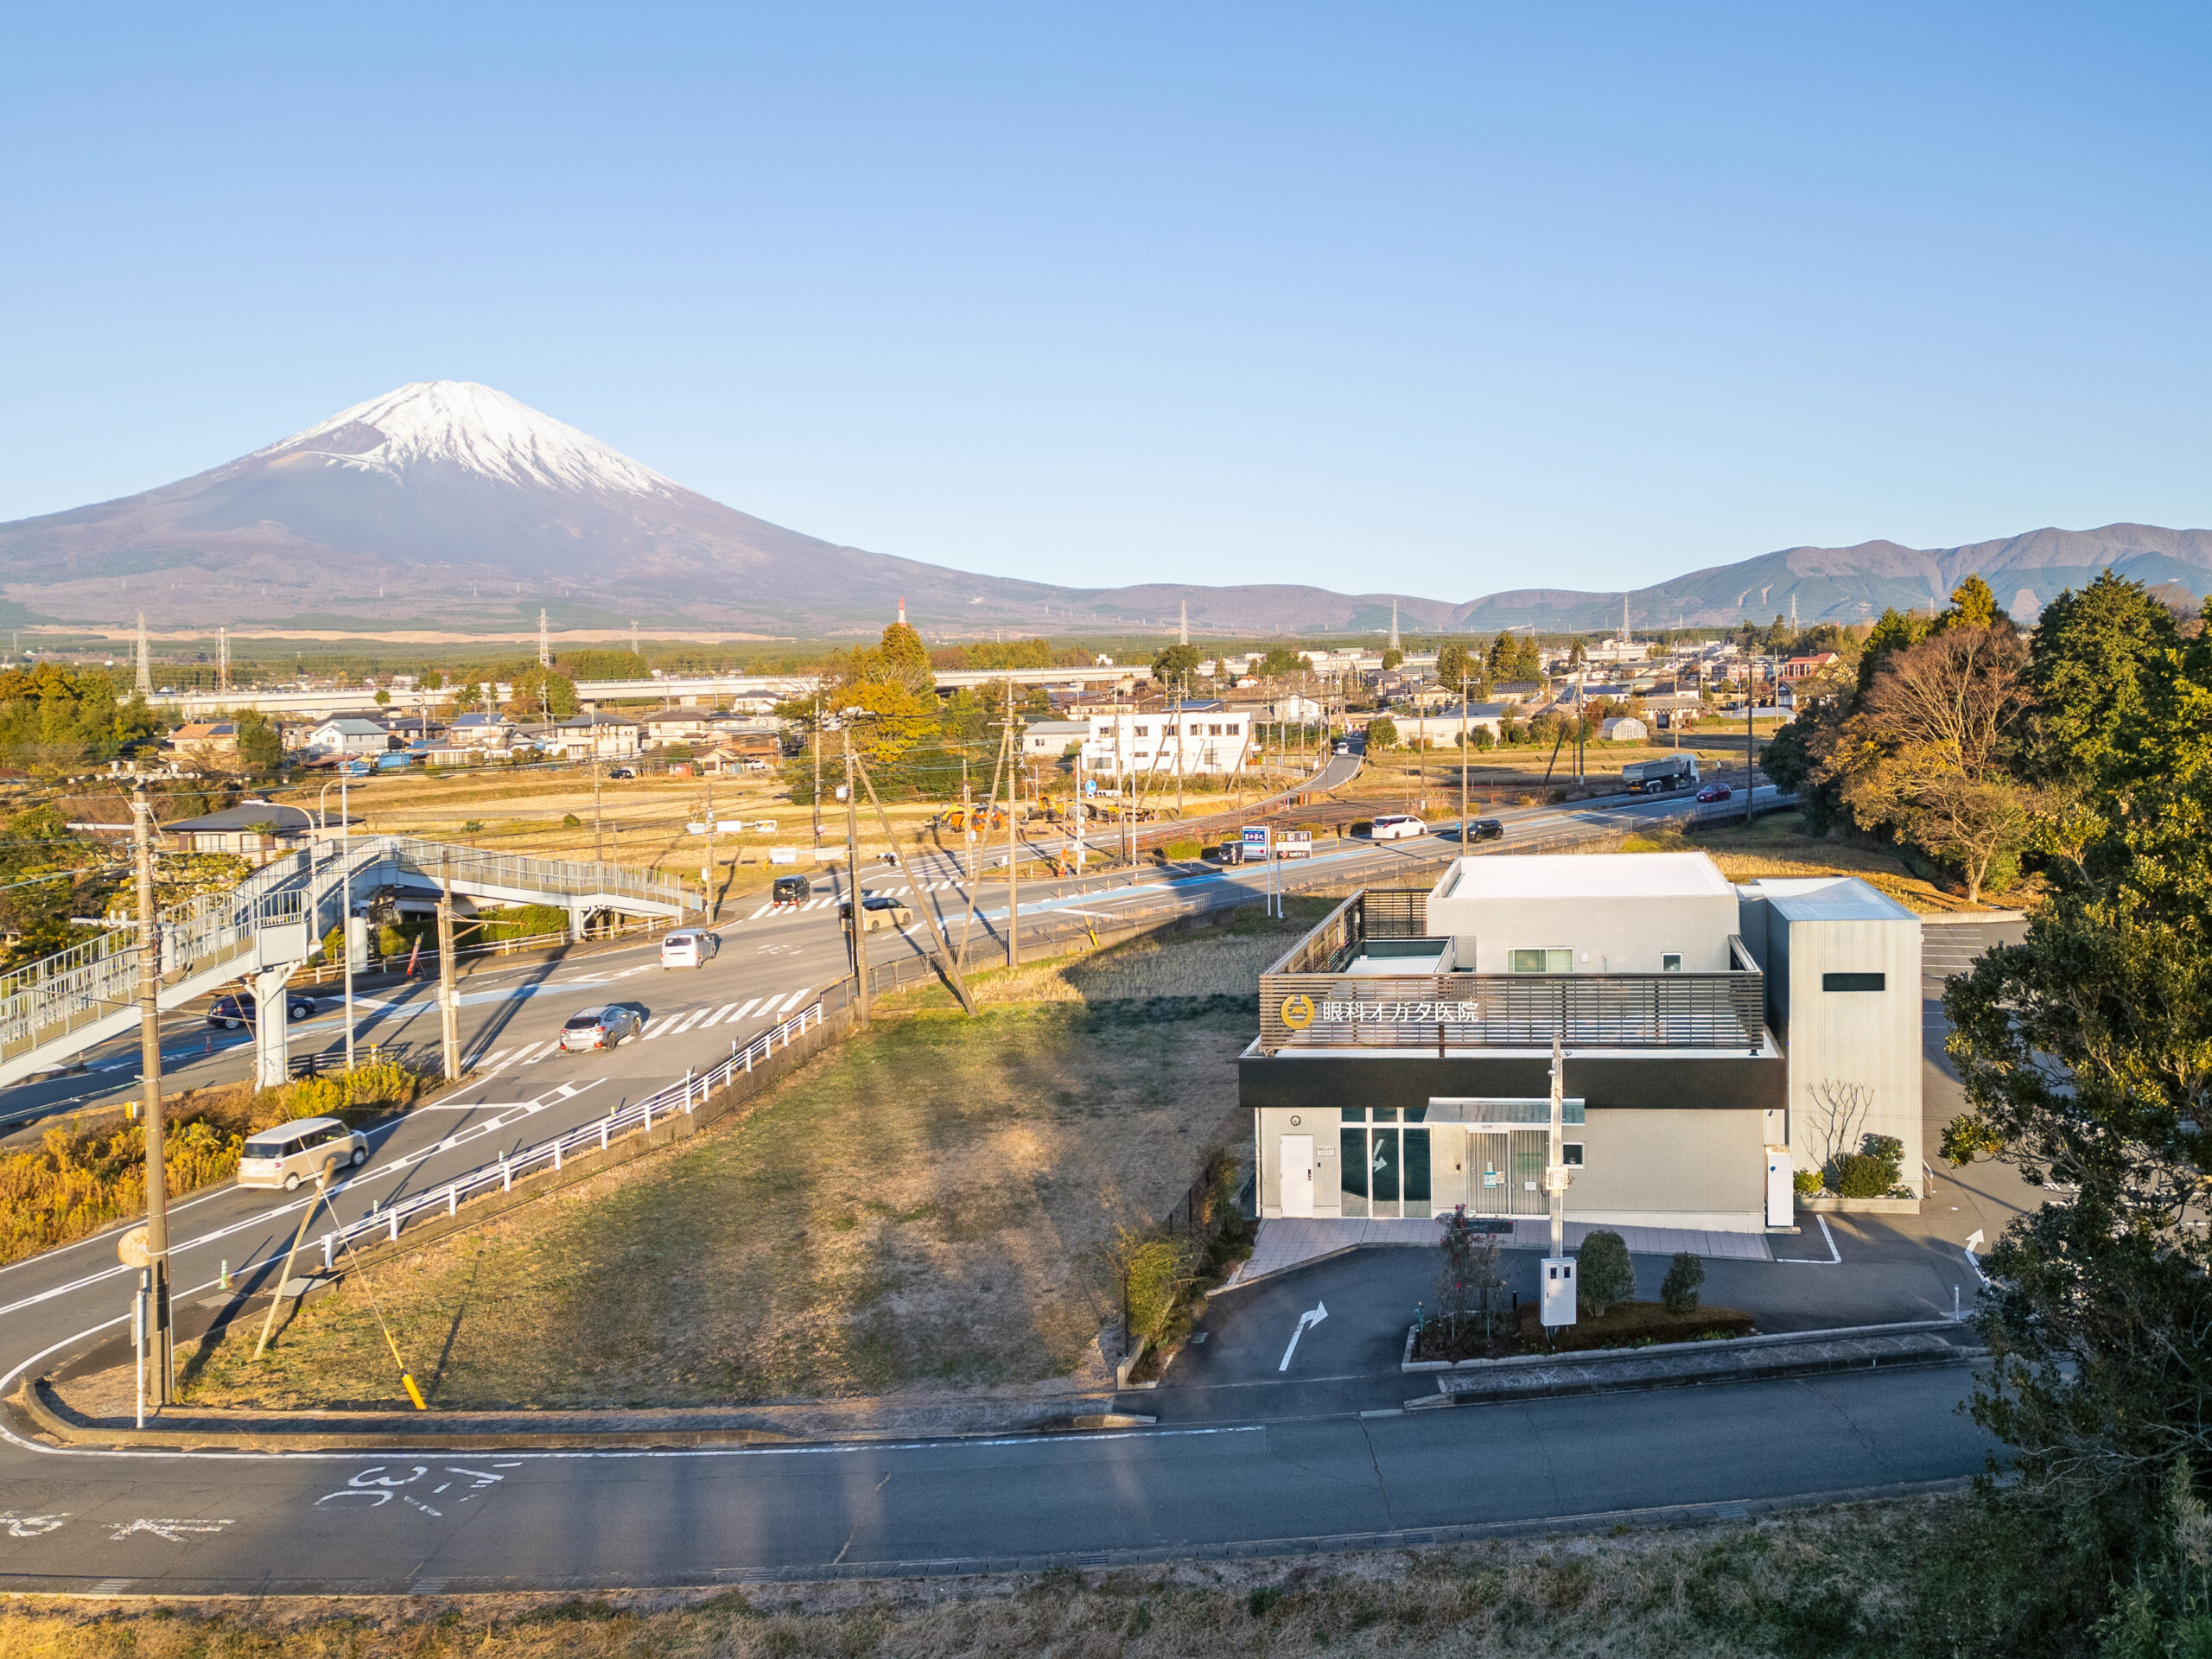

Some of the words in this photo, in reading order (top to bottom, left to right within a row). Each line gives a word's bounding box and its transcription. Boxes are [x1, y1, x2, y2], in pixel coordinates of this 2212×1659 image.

[1322, 1001, 1479, 1022] 眼科オガタ医院
